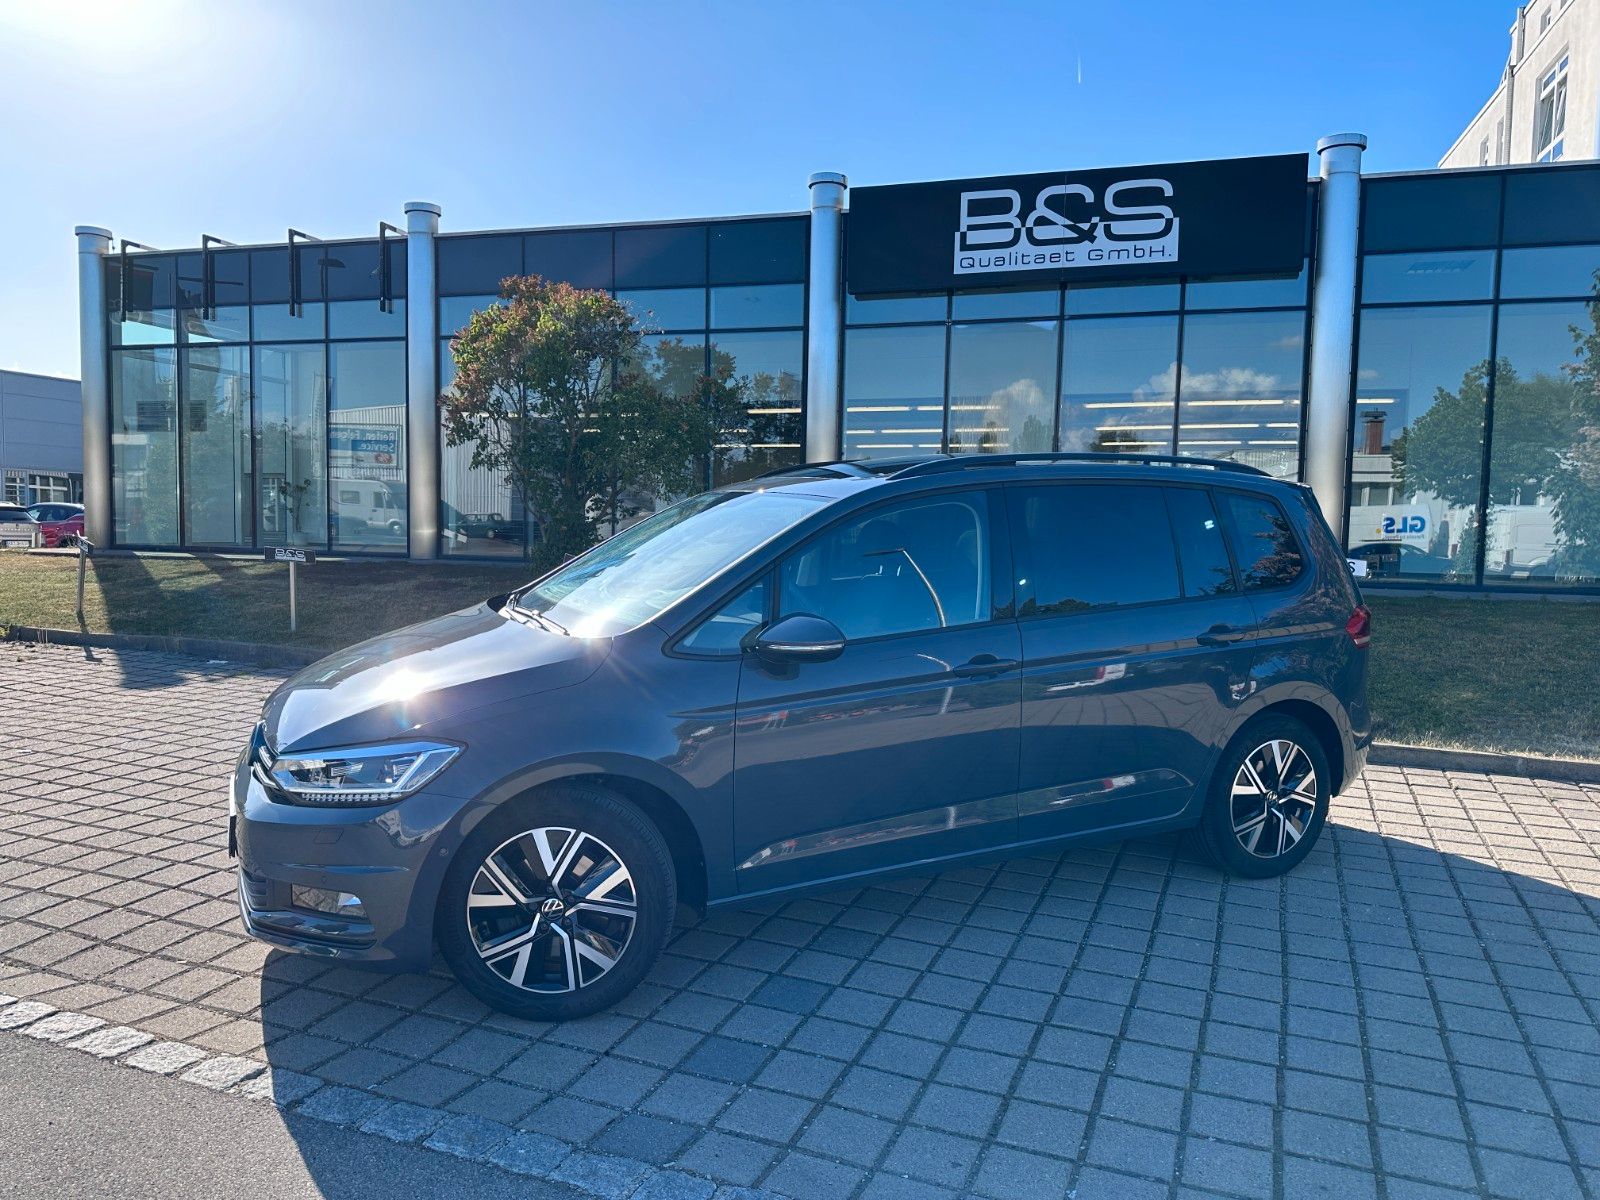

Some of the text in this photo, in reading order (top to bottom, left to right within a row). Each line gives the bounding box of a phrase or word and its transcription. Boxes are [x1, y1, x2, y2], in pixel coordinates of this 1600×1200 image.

[959, 178, 1174, 252] B&S
[959, 245, 1172, 269] Qualitaet GmbH.
[275, 548, 305, 559] B&S
